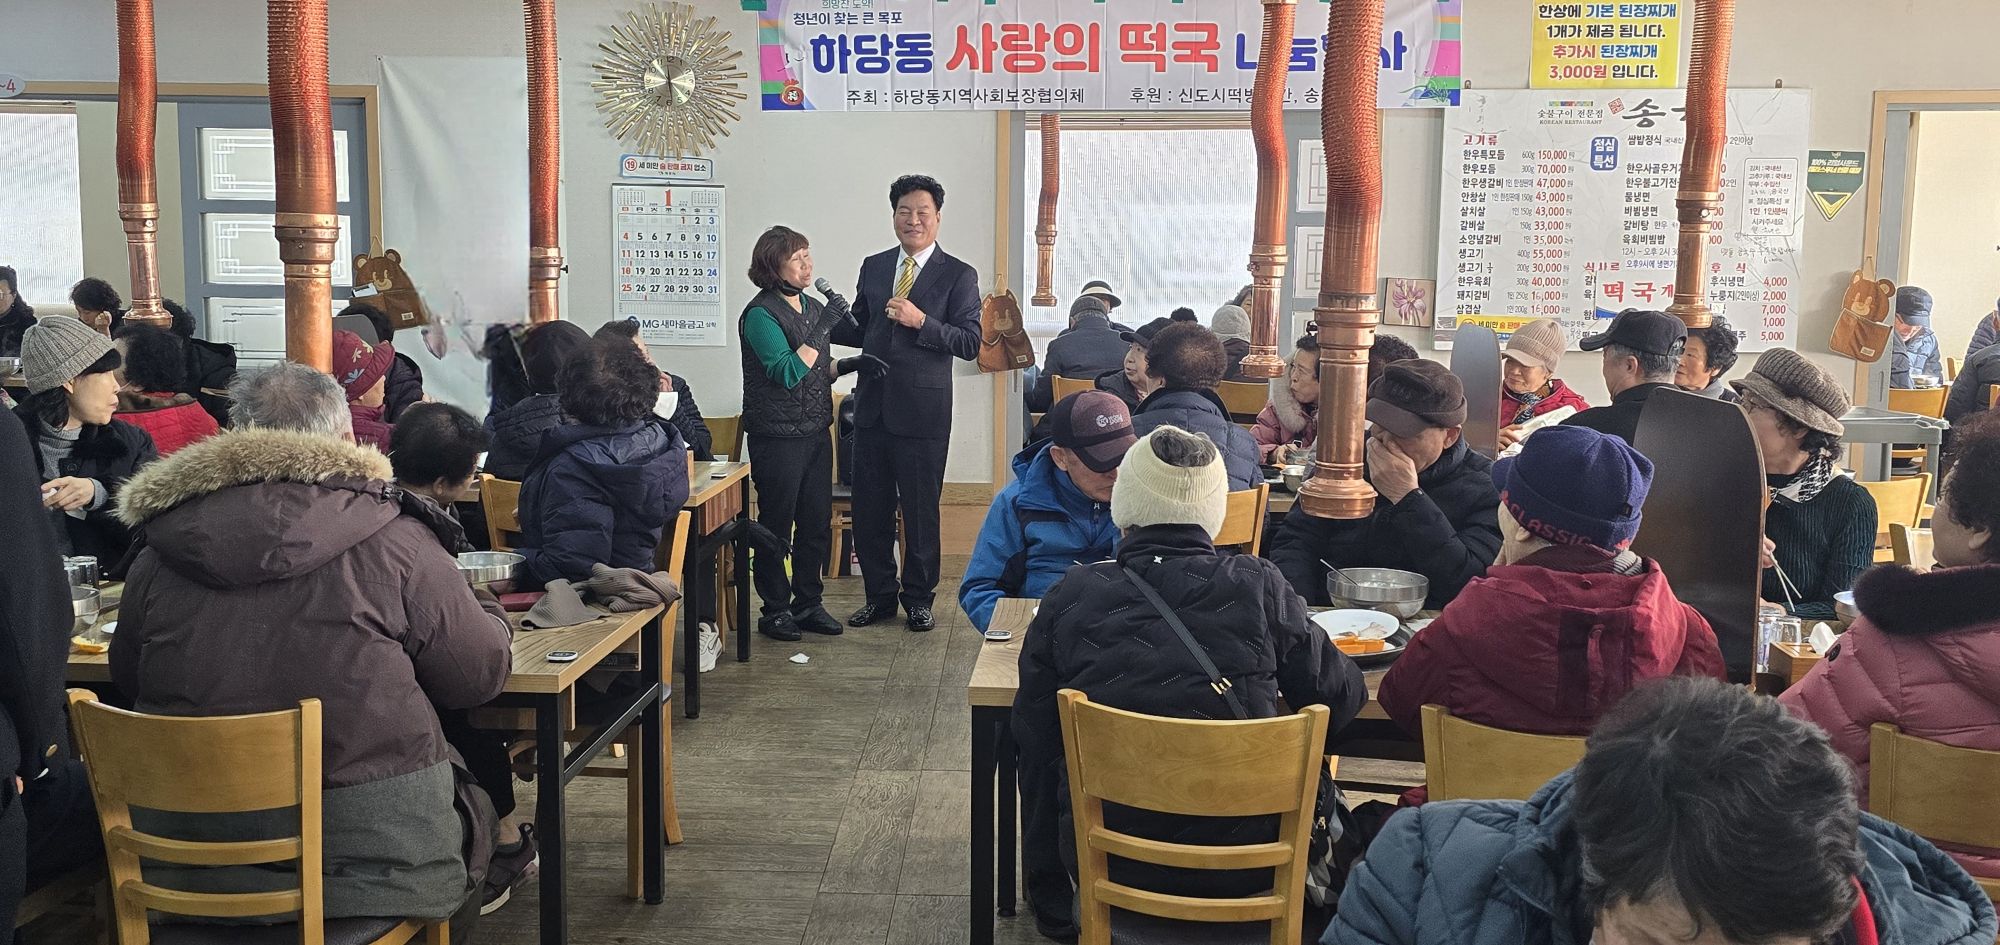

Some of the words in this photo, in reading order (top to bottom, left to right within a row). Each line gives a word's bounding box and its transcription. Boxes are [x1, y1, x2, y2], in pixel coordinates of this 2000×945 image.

[1538, 4, 1581, 18] 한상에
[1585, 4, 1614, 18] 기본
[1619, 4, 1677, 18] 된장찌개
[793, 11, 830, 25] 청년이
[834, 11, 858, 25] 찾는
[862, 11, 874, 25] 큰
[878, 11, 902, 25] 목포
[1547, 24, 1582, 38] 1개가
[1585, 24, 1615, 38] 제공
[1619, 24, 1666, 38] 됩니다.
[809, 33, 934, 74] 하당동
[946, 22, 1101, 73] 사랑의
[1119, 22, 1221, 73] 떡국
[1553, 44, 1596, 59] 추가시
[1600, 44, 1658, 58] 된장찌개
[1549, 65, 1607, 80] 3,000원
[1612, 65, 1658, 78] 입니다.
[846, 88, 878, 105] 주최
[893, 87, 1085, 105] 하당동지역사회보장협의체
[1130, 87, 1162, 104] 후원
[1304, 87, 1320, 104] 송
[1537, 109, 1573, 119] 숯불구이
[1463, 134, 1498, 146] 고기류
[1594, 138, 1615, 152] 점심
[1628, 135, 1662, 146] 쌈밥정식
[1729, 136, 1754, 146] 2인이상
[1463, 150, 1506, 161] 한우특모듬
[1522, 151, 1535, 160] 600g
[1538, 150, 1568, 161] 150,000
[1593, 154, 1614, 168] 특선
[627, 161, 635, 169] 19
[1462, 164, 1496, 175] 한우모듬
[1521, 165, 1534, 174] 300g
[1537, 164, 1567, 175] 70,000
[1462, 178, 1504, 189] 한우생갈비
[1536, 178, 1566, 189] 47,000
[1626, 178, 1680, 188] 한우불고기전
[1725, 179, 1737, 187] 2인
[665, 189, 671, 207] 1
[1461, 192, 1486, 203] 안창살
[1535, 192, 1566, 203] 43,000
[1624, 191, 1650, 202] 물냉면
[1460, 206, 1486, 217] 살치살
[1535, 206, 1565, 217] 43,000
[1624, 205, 1658, 217] 비빔냉면
[1460, 220, 1485, 231] 갈비살
[1534, 220, 1564, 231] 33,000
[1623, 220, 1649, 231] 갈비탕
[652, 233, 657, 241] 6
[666, 233, 671, 241] 7
[707, 234, 717, 242] 10
[1458, 234, 1501, 245] 소양념갈비
[1533, 235, 1563, 246] 35,000
[1622, 234, 1666, 245] 육회비빔밥
[635, 250, 646, 258] 12
[650, 250, 660, 258] 13
[678, 251, 689, 259] 15
[692, 251, 703, 259] 16
[1458, 248, 1484, 259] 생고기
[1532, 249, 1563, 260] 55,000
[1643, 247, 1658, 256] 오후
[1659, 247, 1670, 256] 2시
[1457, 262, 1483, 273] 생고기
[1532, 263, 1562, 274] 30,000
[1626, 260, 1655, 268] 오후9시에
[621, 267, 631, 275] 18
[635, 267, 646, 275] 19
[664, 268, 674, 276] 21
[678, 268, 689, 276] 22
[706, 269, 717, 277] 24
[1457, 276, 1491, 287] 한우육회
[1531, 277, 1561, 288] 40,000
[1710, 275, 1745, 287] 후식냉면
[1764, 276, 1788, 287] 4,000
[621, 284, 632, 292] 25
[650, 285, 660, 293] 27
[692, 286, 703, 294] 30
[1456, 290, 1490, 301] 돼지갈비
[1763, 290, 1787, 301] 2,000
[1456, 304, 1481, 315] 삼겹살
[1531, 304, 1560, 316] 16,000
[1761, 305, 1786, 316] 7,000
[1763, 317, 1785, 328] 1,000
[1761, 331, 1785, 342] 5,000
